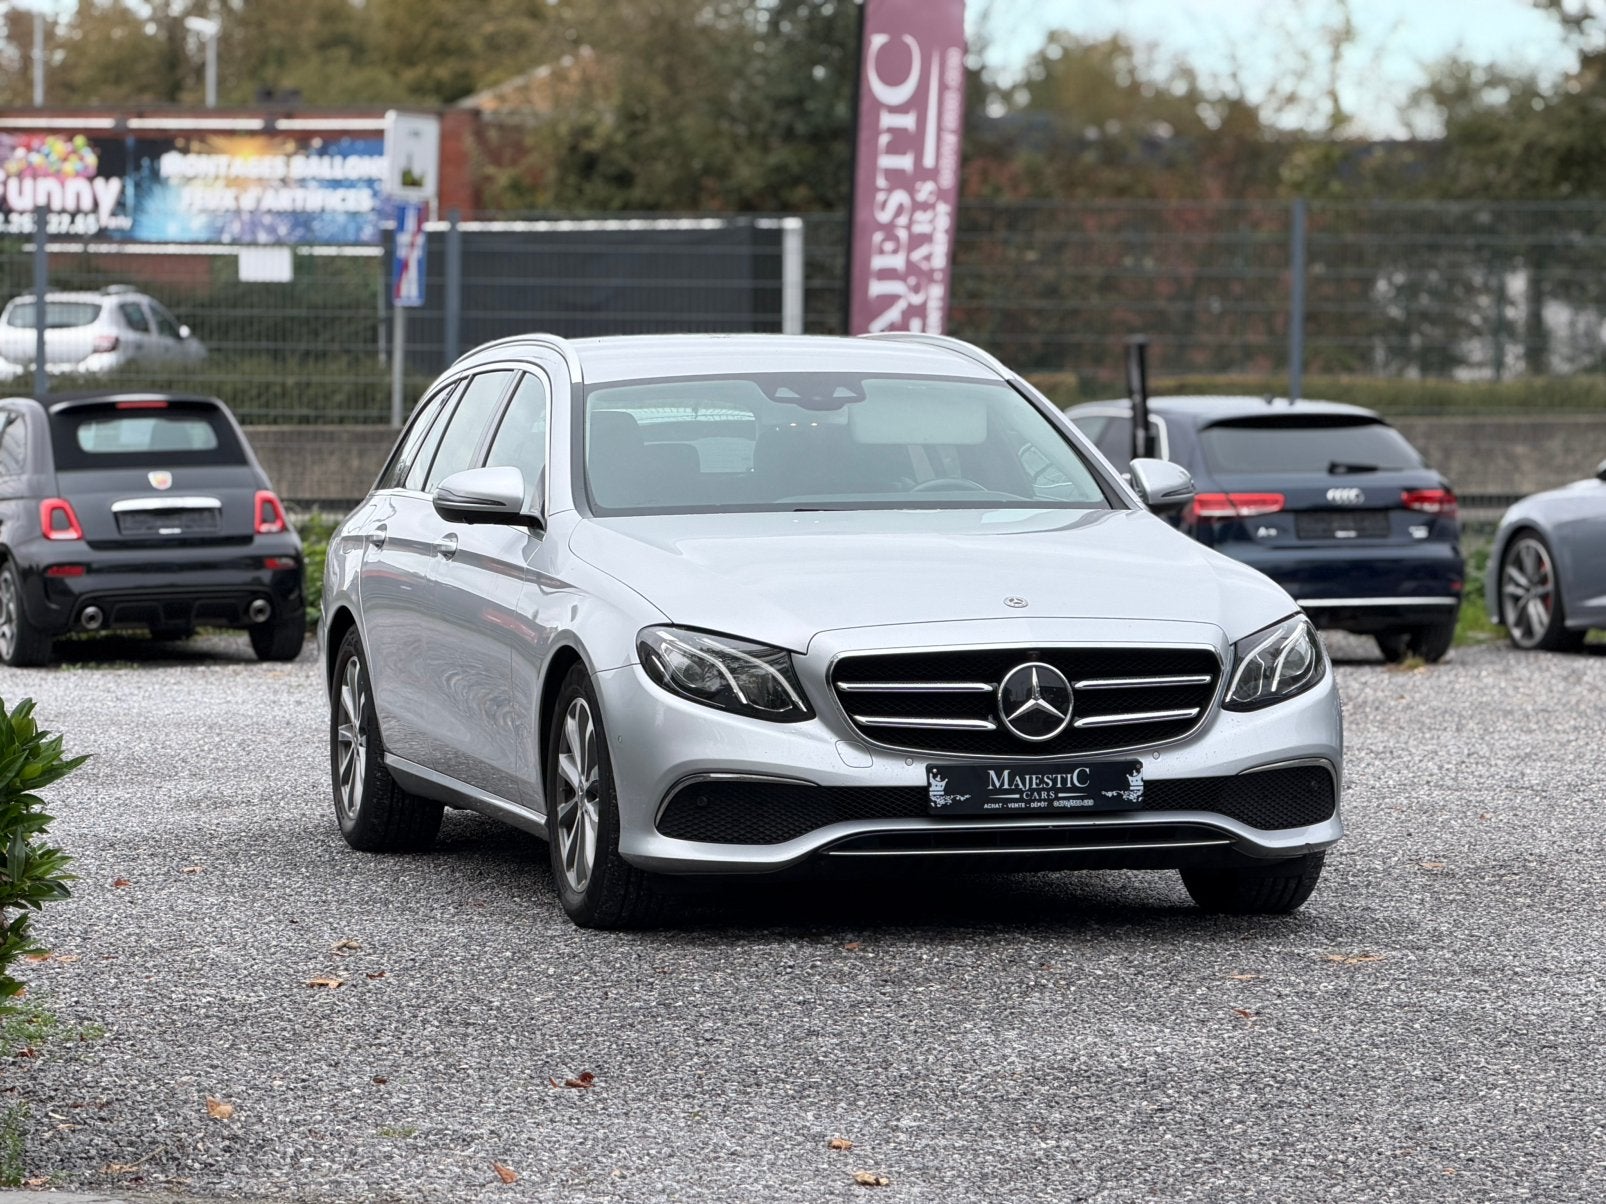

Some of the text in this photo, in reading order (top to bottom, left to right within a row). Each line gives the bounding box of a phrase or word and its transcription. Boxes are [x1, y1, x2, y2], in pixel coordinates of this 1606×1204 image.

[0, 175, 122, 229] unny
[906, 180, 938, 307] CARS
[987, 767, 1090, 790] MAJESTIC
[1023, 791, 1055, 799] CARS
